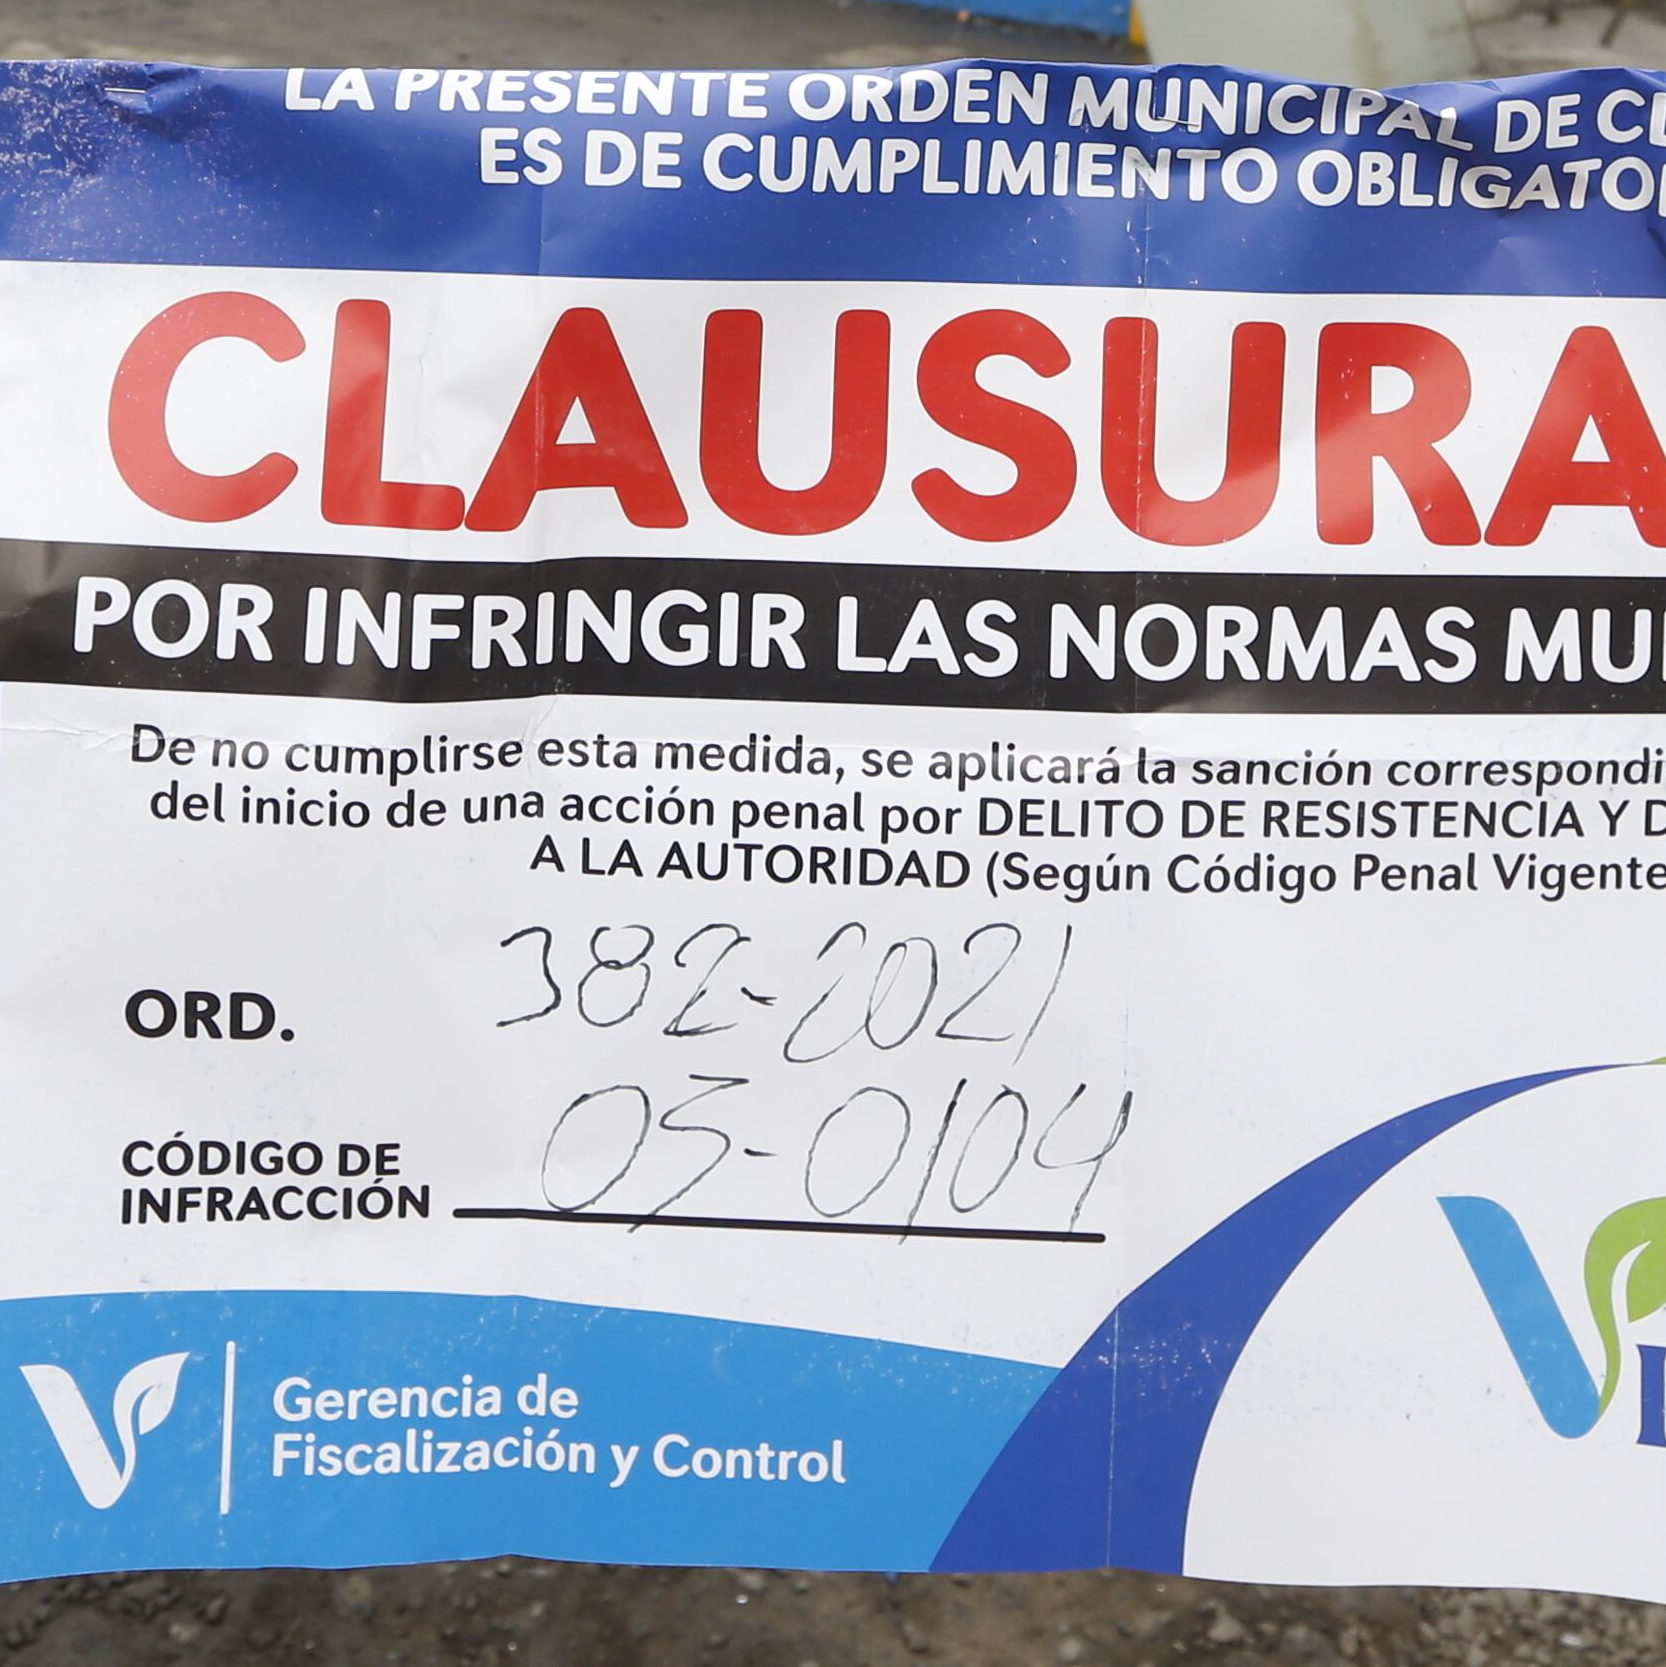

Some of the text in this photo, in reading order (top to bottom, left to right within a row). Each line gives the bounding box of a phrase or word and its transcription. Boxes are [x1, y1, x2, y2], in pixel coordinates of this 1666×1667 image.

[284, 67, 375, 111] LA
[394, 68, 769, 119] PRESENTE
[787, 69, 1049, 127] ORDEN
[1070, 75, 1473, 153] MUNICIPAL
[1492, 90, 1580, 155] DE
[479, 127, 562, 187] ES
[584, 131, 683, 190] DE
[702, 131, 1278, 205] CUMPLIMIENTO
[72, 574, 274, 665] POR
[302, 585, 806, 672] INFRINGIR
[835, 592, 1020, 678] LAS
[1046, 601, 1476, 685] NORMAS
[131, 724, 196, 767] De
[211, 744, 269, 771] no
[285, 736, 524, 787] cumplirse
[538, 734, 637, 769] esta
[654, 733, 846, 785] medida,
[860, 749, 913, 778] se
[929, 742, 1121, 791] aplicará
[1136, 748, 1176, 785] la
[1191, 749, 1372, 787] sanción
[150, 781, 225, 823] del
[240, 786, 370, 828] inicio
[385, 789, 447, 829] de
[462, 789, 545, 824] una
[559, 785, 715, 826] acción
[732, 791, 865, 838] penal
[881, 802, 962, 843] por
[978, 796, 1164, 839] DELITO
[1181, 798, 1246, 839] DE
[1262, 798, 1579, 840] RESISTENCIA
[1600, 799, 1630, 837] Y
[530, 834, 566, 874] A
[580, 838, 644, 879] LA
[657, 841, 971, 890] AUTORIDAD
[986, 848, 1152, 902] (Según
[1167, 851, 1337, 904] Código
[1352, 852, 1477, 893] Penal
[123, 987, 296, 1043] ORD.
[121, 1130, 401, 1177] CÓDIGO DE
[120, 1176, 431, 1224] INFRACCIÓN
[272, 1373, 580, 1423] Gerencia de
[272, 1428, 847, 1489] Fiscalización y Control
